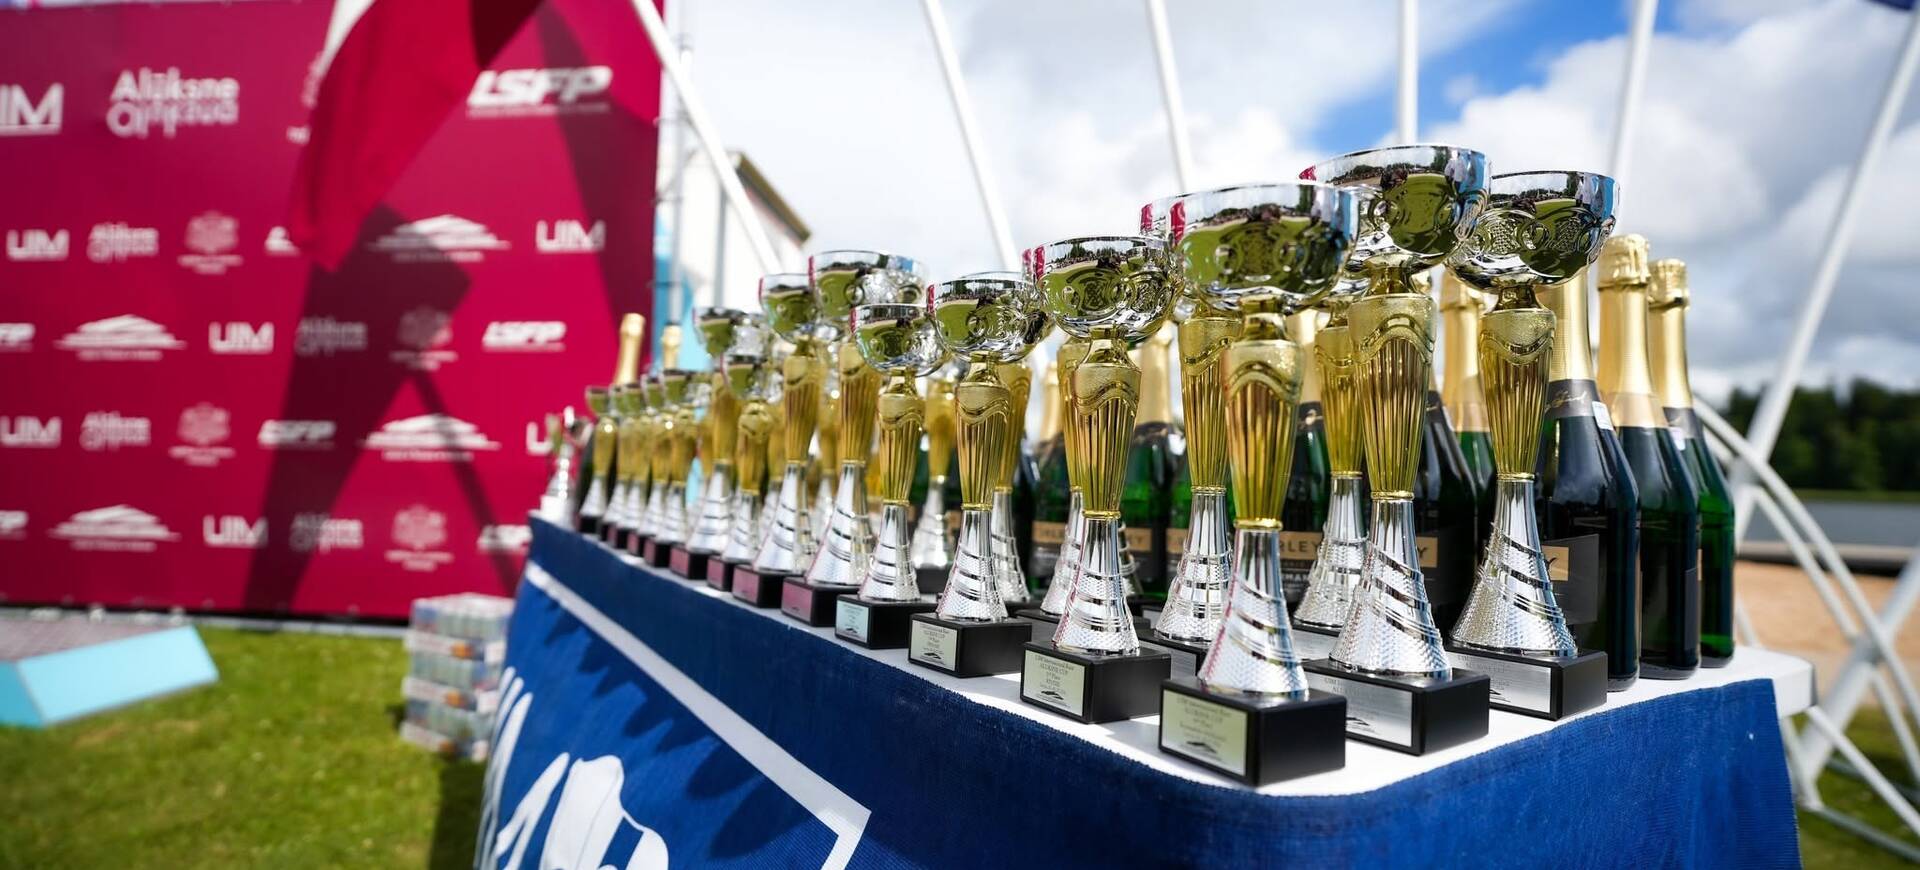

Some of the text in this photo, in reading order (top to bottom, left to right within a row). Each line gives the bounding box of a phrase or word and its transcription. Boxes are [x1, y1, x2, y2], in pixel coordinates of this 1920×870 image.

[0, 83, 64, 136] IM
[6, 228, 70, 261] UIM
[536, 219, 606, 253] UIM
[208, 321, 275, 354] UIM
